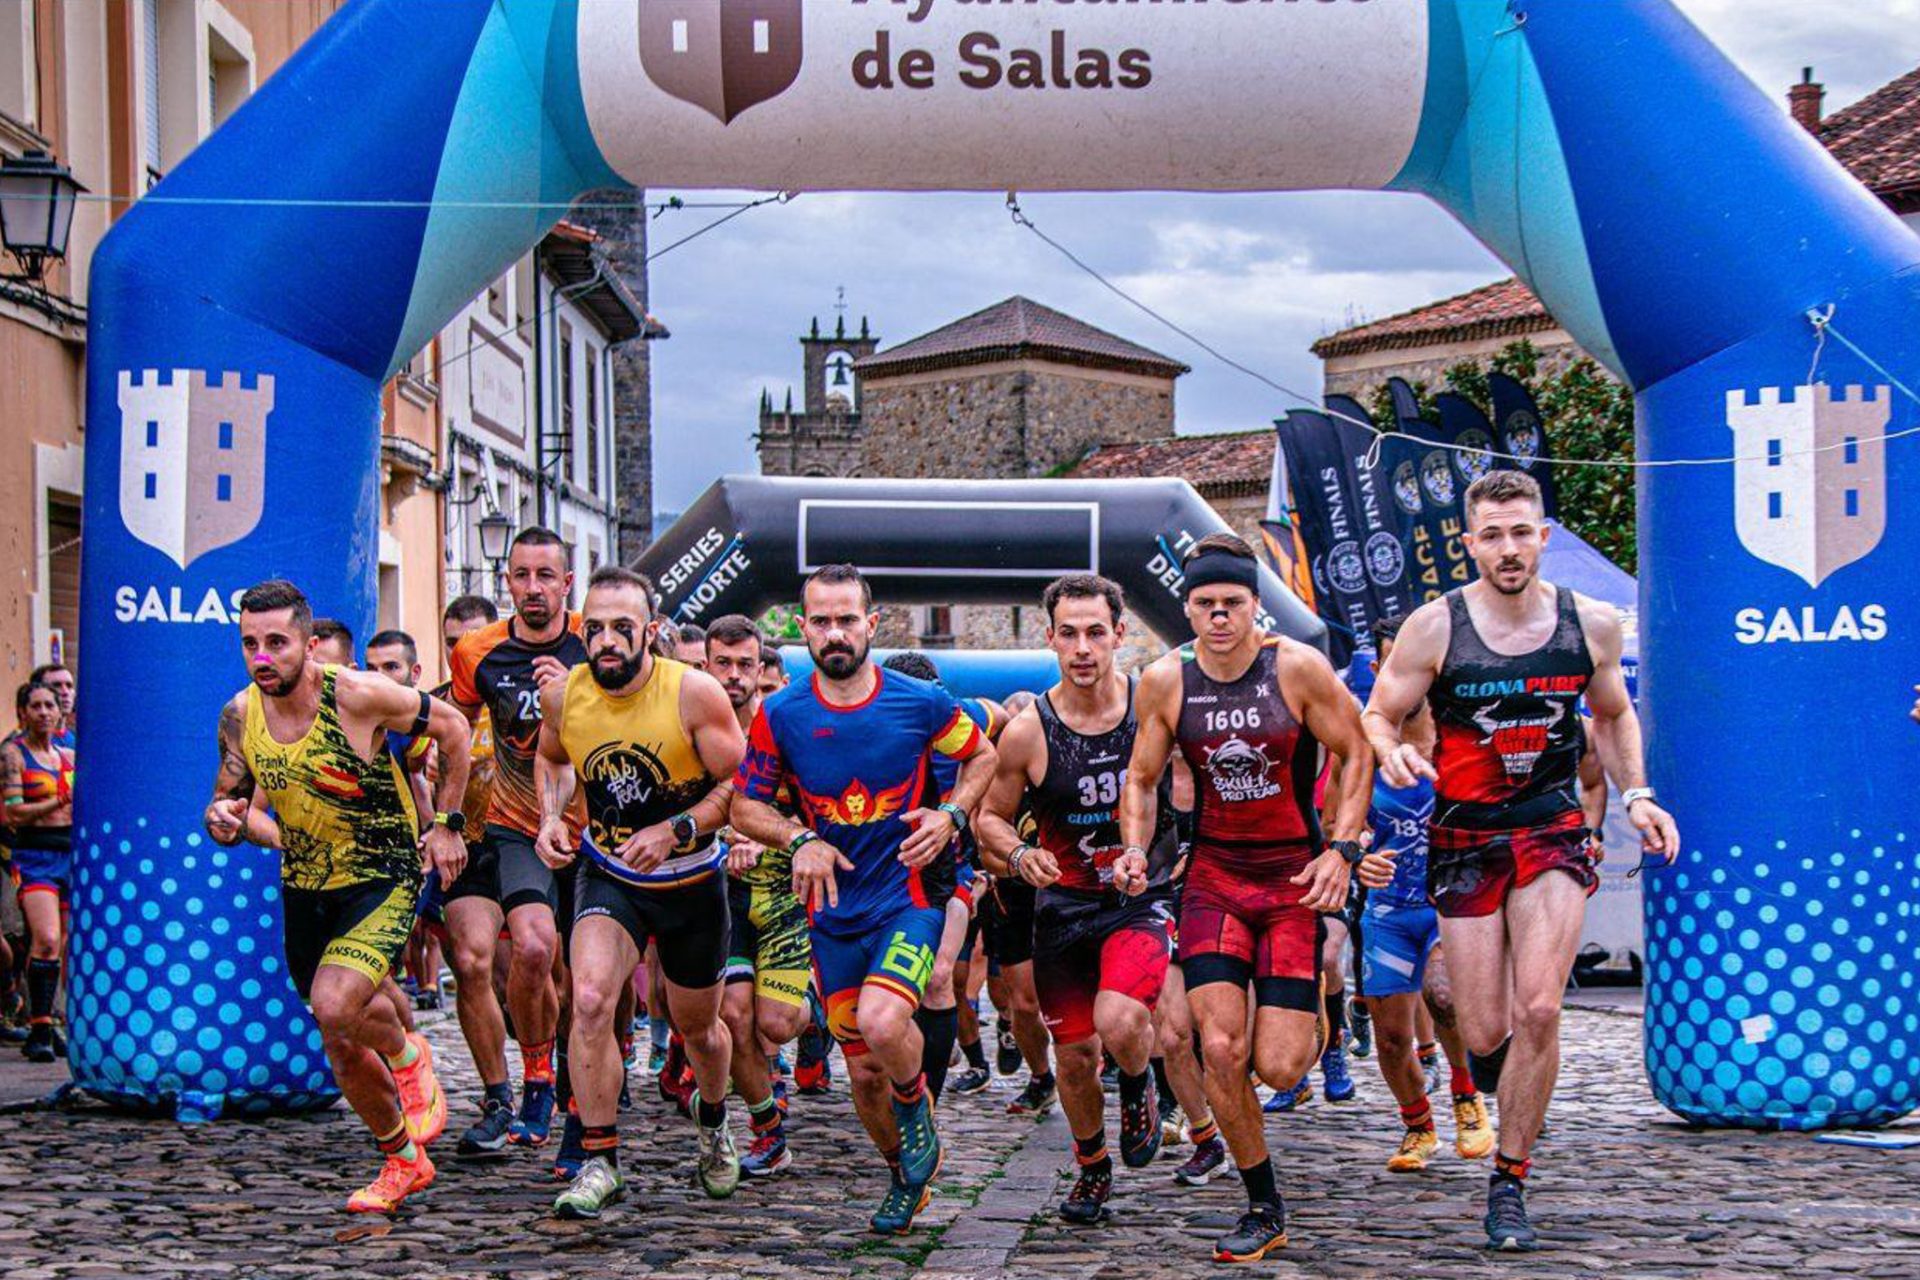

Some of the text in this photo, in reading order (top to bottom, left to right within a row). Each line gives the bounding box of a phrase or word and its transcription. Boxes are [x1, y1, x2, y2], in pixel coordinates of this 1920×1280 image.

[851, 30, 1152, 89] de Salas
[1320, 466, 1350, 540] FINALS
[659, 526, 724, 594] SERIES
[1441, 516, 1469, 580] ACE
[680, 549, 751, 620] NORTE
[1145, 553, 1186, 598] DEL
[1734, 604, 1888, 645] SALAS
[1205, 707, 1261, 732] 1606
[260, 771, 287, 790] 336
[1078, 768, 1130, 806] 33
